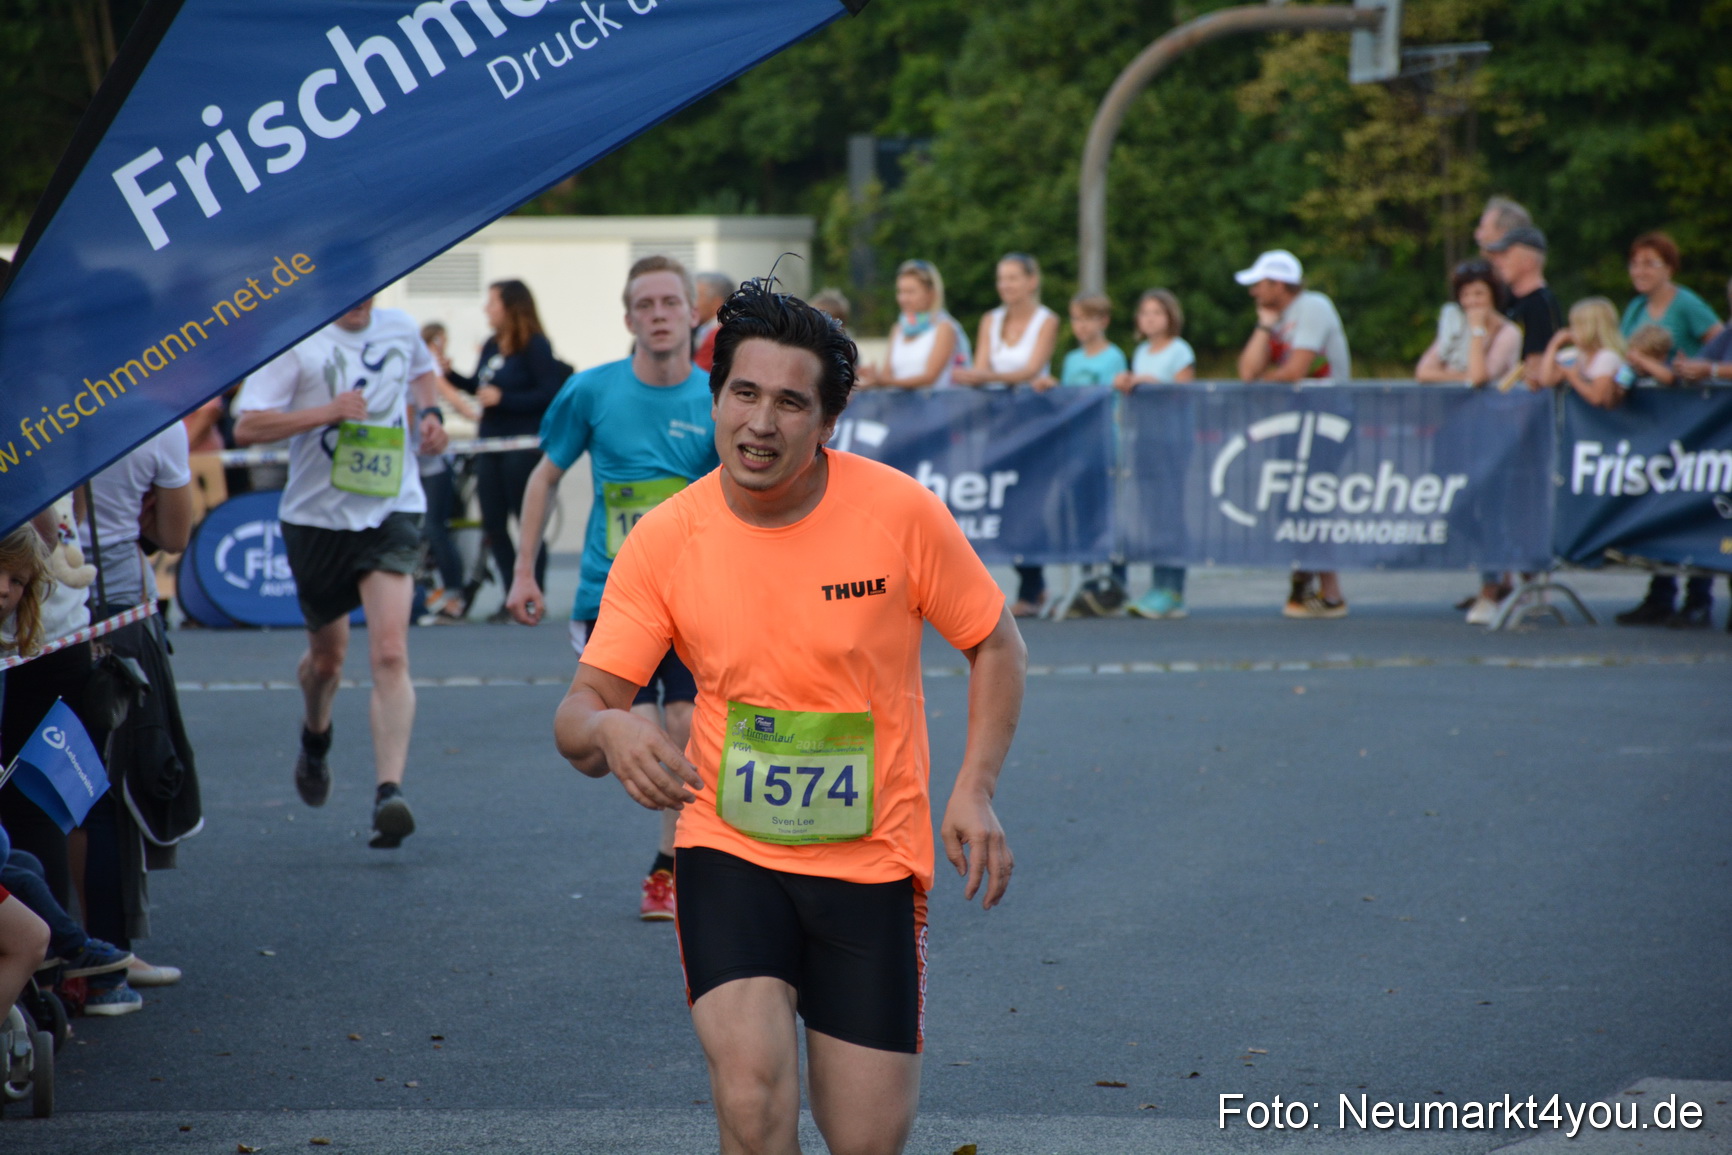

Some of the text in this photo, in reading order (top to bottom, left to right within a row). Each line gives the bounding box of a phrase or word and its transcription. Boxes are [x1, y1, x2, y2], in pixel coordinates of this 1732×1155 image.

[486, 1, 623, 100] Druck
[350, 451, 392, 477] 343
[1256, 459, 1467, 514] Fischer
[1274, 519, 1449, 544] AUTOMOBILE
[821, 578, 886, 601] THULE
[735, 760, 859, 807] 1574
[772, 816, 815, 826] Sven Lee
